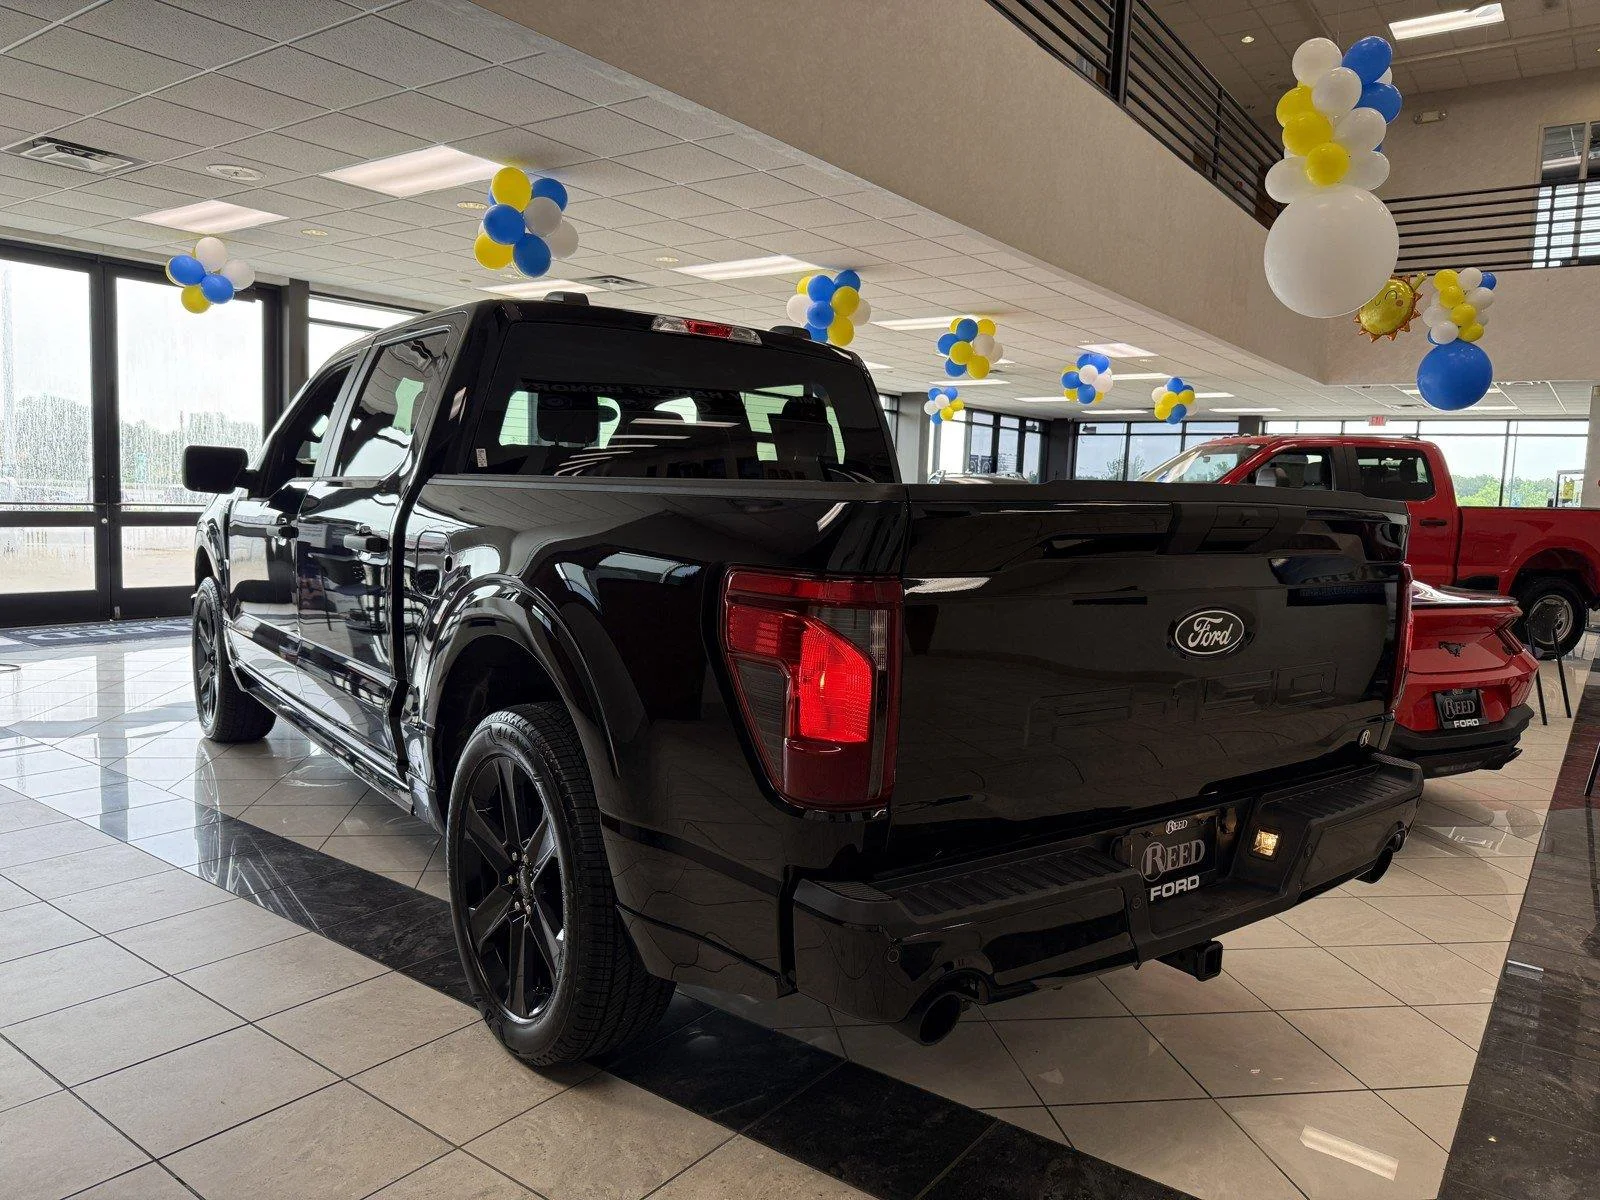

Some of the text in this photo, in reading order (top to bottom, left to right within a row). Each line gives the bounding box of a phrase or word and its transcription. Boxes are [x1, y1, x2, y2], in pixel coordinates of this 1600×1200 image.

[1188, 617, 1233, 648] Ford
[1443, 698, 1475, 719] REED
[1453, 719, 1479, 728] FORD
[1166, 820, 1188, 834] REED
[1142, 840, 1205, 880] REED
[1150, 874, 1200, 901] FORD
